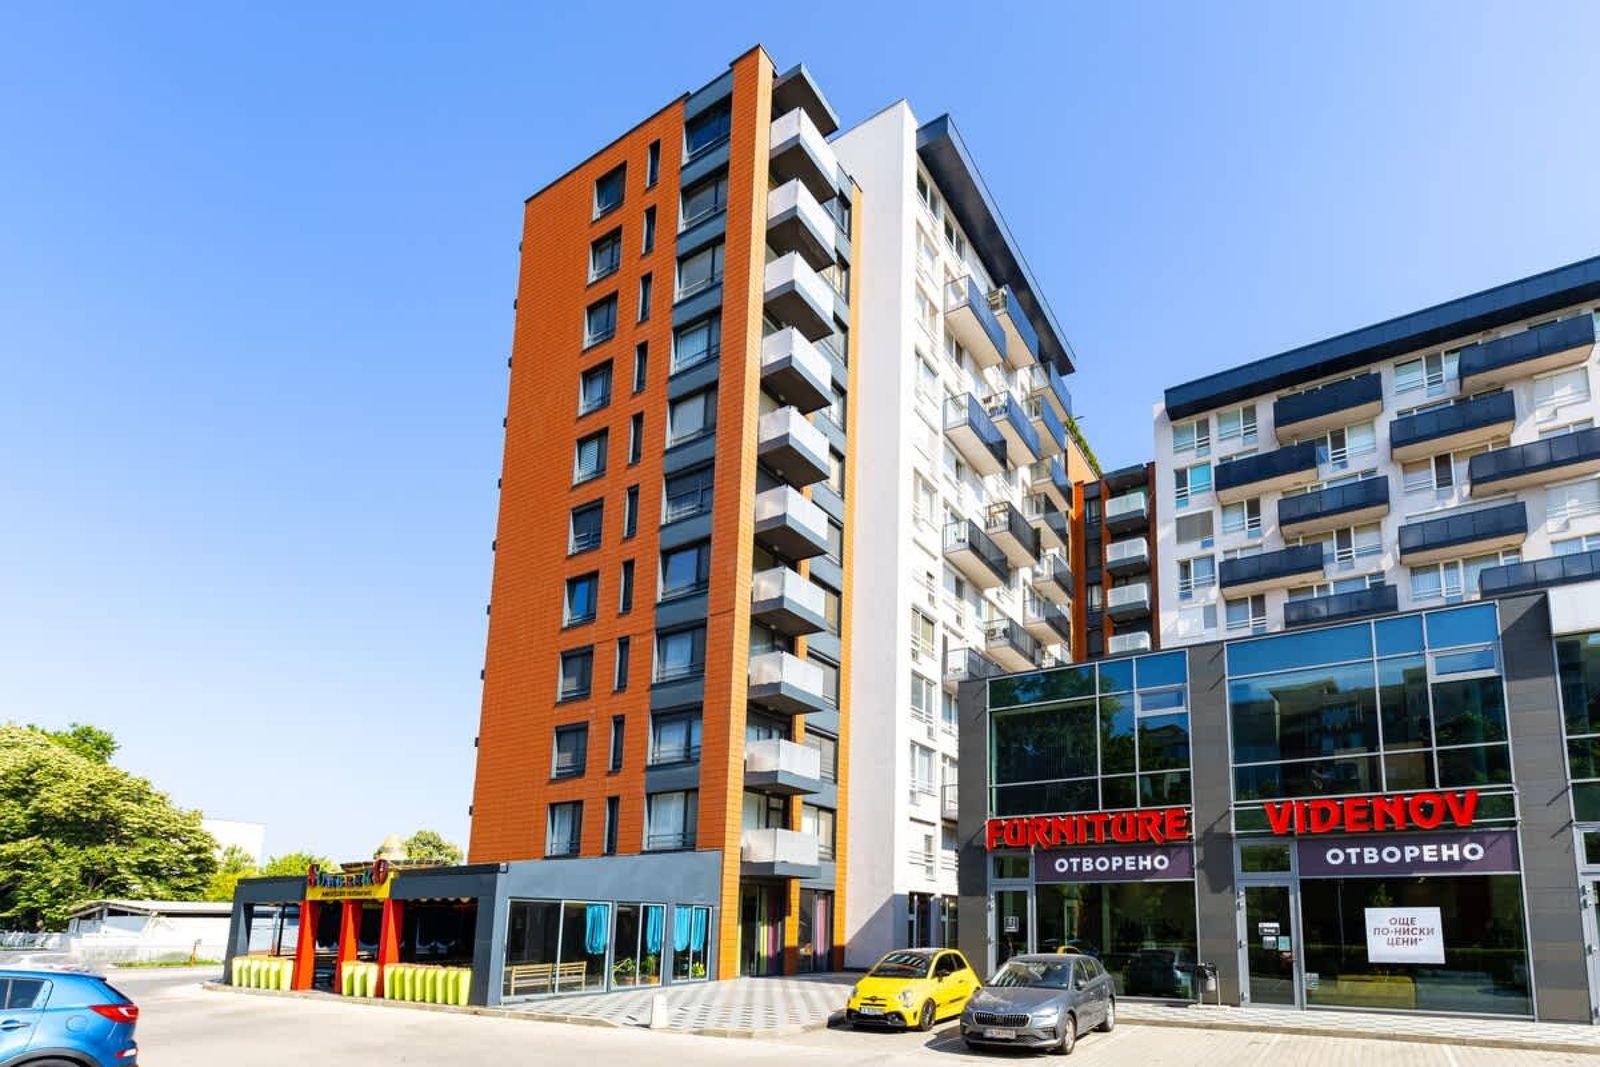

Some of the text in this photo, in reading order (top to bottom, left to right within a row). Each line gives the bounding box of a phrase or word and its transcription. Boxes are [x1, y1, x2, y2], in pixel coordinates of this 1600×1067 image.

[1264, 790, 1479, 836] VIDENOV
[986, 808, 1191, 851] FURNITURE
[1326, 842, 1485, 865] ОТВОРЕНО
[1054, 855, 1170, 873] ОТВОРЕНО
[1373, 927, 1435, 936] ПО-НИСКИ
[1389, 917, 1417, 927] ОЩЕ
